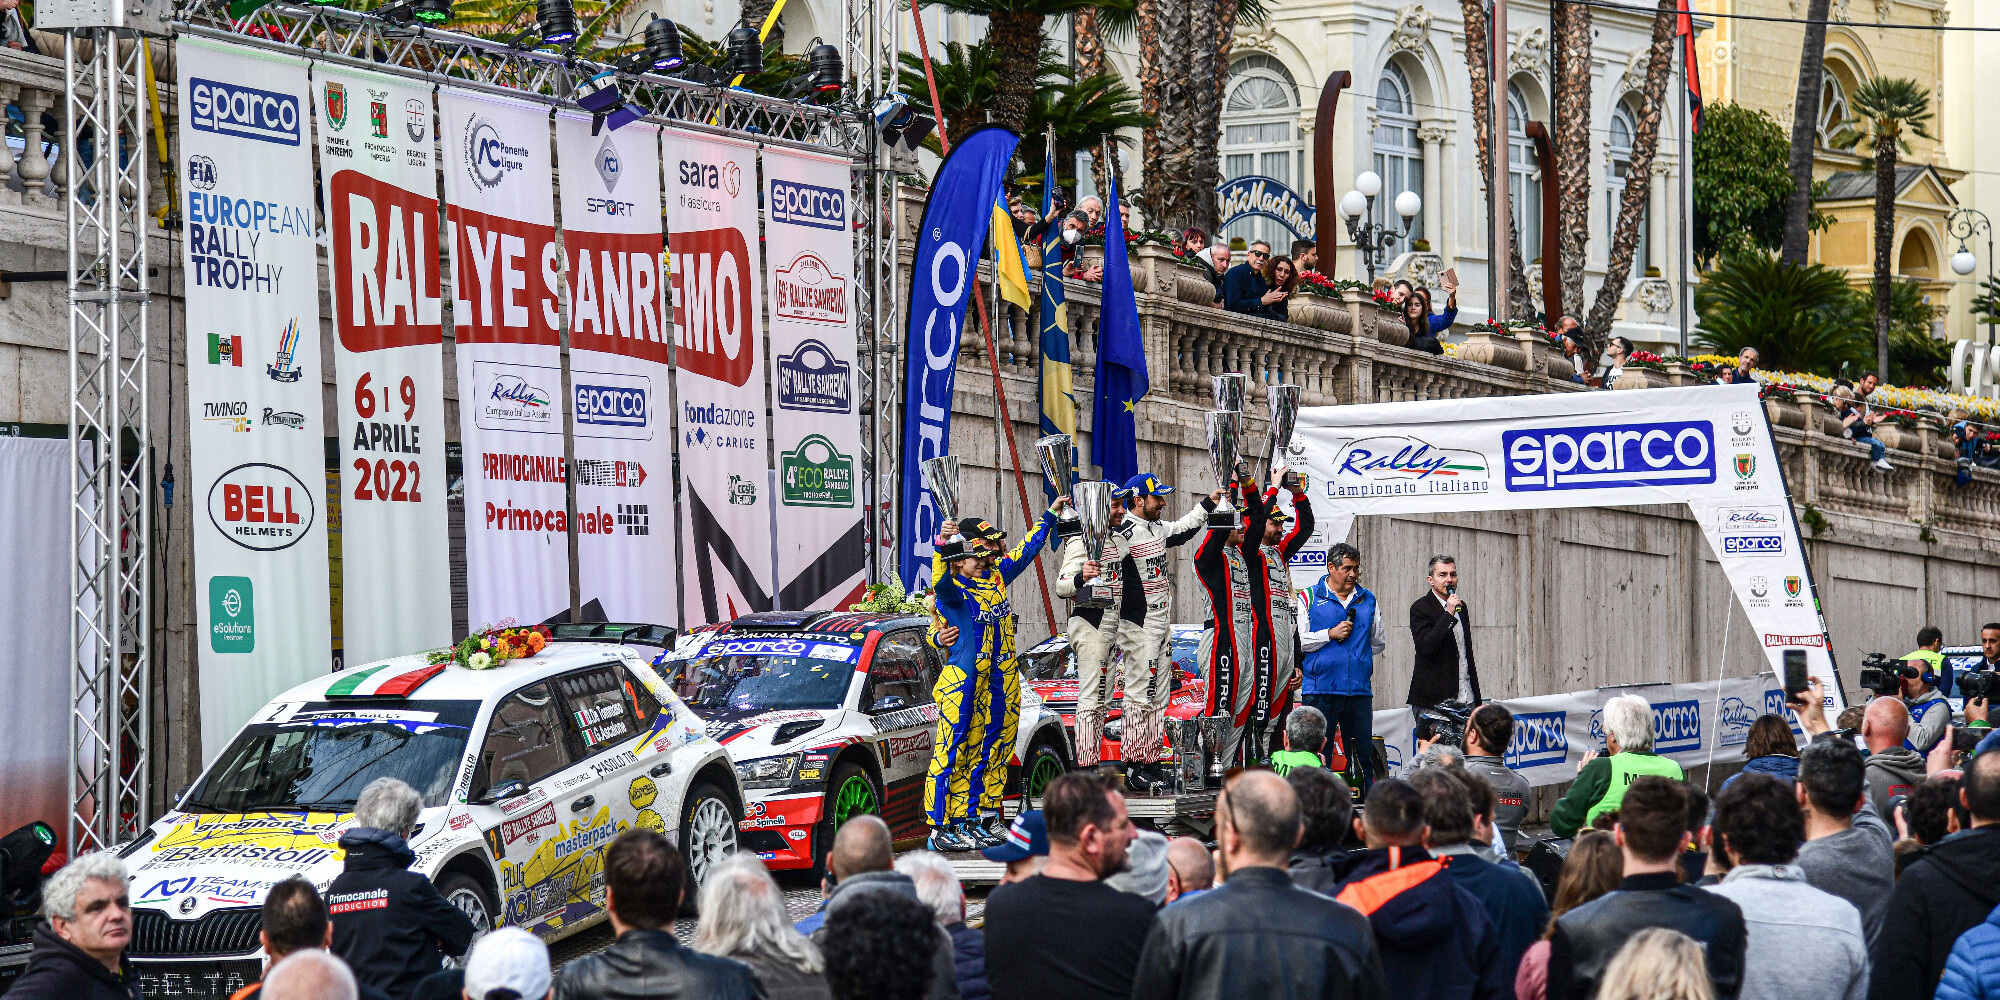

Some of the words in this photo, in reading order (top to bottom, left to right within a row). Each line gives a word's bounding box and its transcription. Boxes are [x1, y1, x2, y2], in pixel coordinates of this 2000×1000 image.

[194, 83, 297, 131] sparco
[501, 142, 529, 157] Ponente
[501, 156, 523, 171] Ligure
[679, 160, 719, 190] sara
[189, 190, 311, 238] EUROPEAN
[586, 198, 634, 217] SPORT
[680, 194, 686, 207] ti
[687, 196, 721, 213] assicura
[773, 183, 843, 222] sparco
[190, 222, 260, 262] RALLY
[191, 254, 282, 295] TROPHY
[348, 192, 530, 329] RALLYE
[541, 241, 742, 362] SANREMO
[789, 282, 813, 308] RALLYE
[813, 286, 844, 316] SANREMO
[490, 382, 535, 408] Rally
[792, 369, 816, 394] RALLYE
[816, 371, 847, 401] SANREMO
[353, 370, 376, 420] 6
[399, 375, 416, 424] 9
[577, 388, 644, 423] sparco
[203, 401, 248, 417] TWINGO
[684, 399, 755, 428] fondazione
[353, 422, 421, 455] APRILE
[716, 436, 755, 450] CARIGE
[482, 452, 566, 484] PRIMOCANALE
[1337, 444, 1452, 480] Rally
[1509, 427, 1709, 488] sparco
[353, 458, 422, 502] 2022
[798, 466, 823, 489] ECO
[823, 467, 849, 481] RALLYE
[824, 480, 849, 490] SANREMO
[1327, 480, 1416, 498] Campionato
[1429, 480, 1489, 493] Italiano
[224, 484, 300, 524] BELL
[485, 498, 614, 535] Primocanale
[1729, 512, 1765, 522] Rally
[235, 526, 293, 537] HELMETS
[1726, 537, 1781, 553] sparco
[213, 622, 251, 634] eSolutions
[741, 631, 849, 643] MUNARETTO
[706, 640, 806, 658] sparco
[1767, 635, 1790, 646] RALLYE
[1791, 635, 1823, 646] SANREMO
[1217, 654, 1230, 718] CITROË
[624, 680, 646, 720] 2
[266, 703, 289, 722] 2
[311, 712, 351, 720] DELTA
[359, 712, 402, 720] RALLY
[1721, 704, 1749, 730] Rally
[1651, 704, 1699, 753] parco
[621, 750, 639, 762] TIR
[459, 753, 475, 790] RIBOLDI
[799, 769, 820, 779] OMP
[448, 812, 470, 826] METECO
[511, 817, 531, 838] RALLYE
[530, 803, 555, 828] SANREMO
[756, 815, 785, 828] Spinelli
[489, 829, 500, 861] 2
[526, 831, 540, 843] BELL
[555, 817, 619, 860] masterpack
[164, 843, 336, 867] Battistolli
[221, 858, 314, 873] INTEGRATI
[139, 876, 198, 899] ACI
[187, 884, 257, 899] ITALIA
[199, 876, 260, 889] TEAM
[329, 888, 388, 904] Primocanale
[330, 899, 386, 913] PRODUCTION
